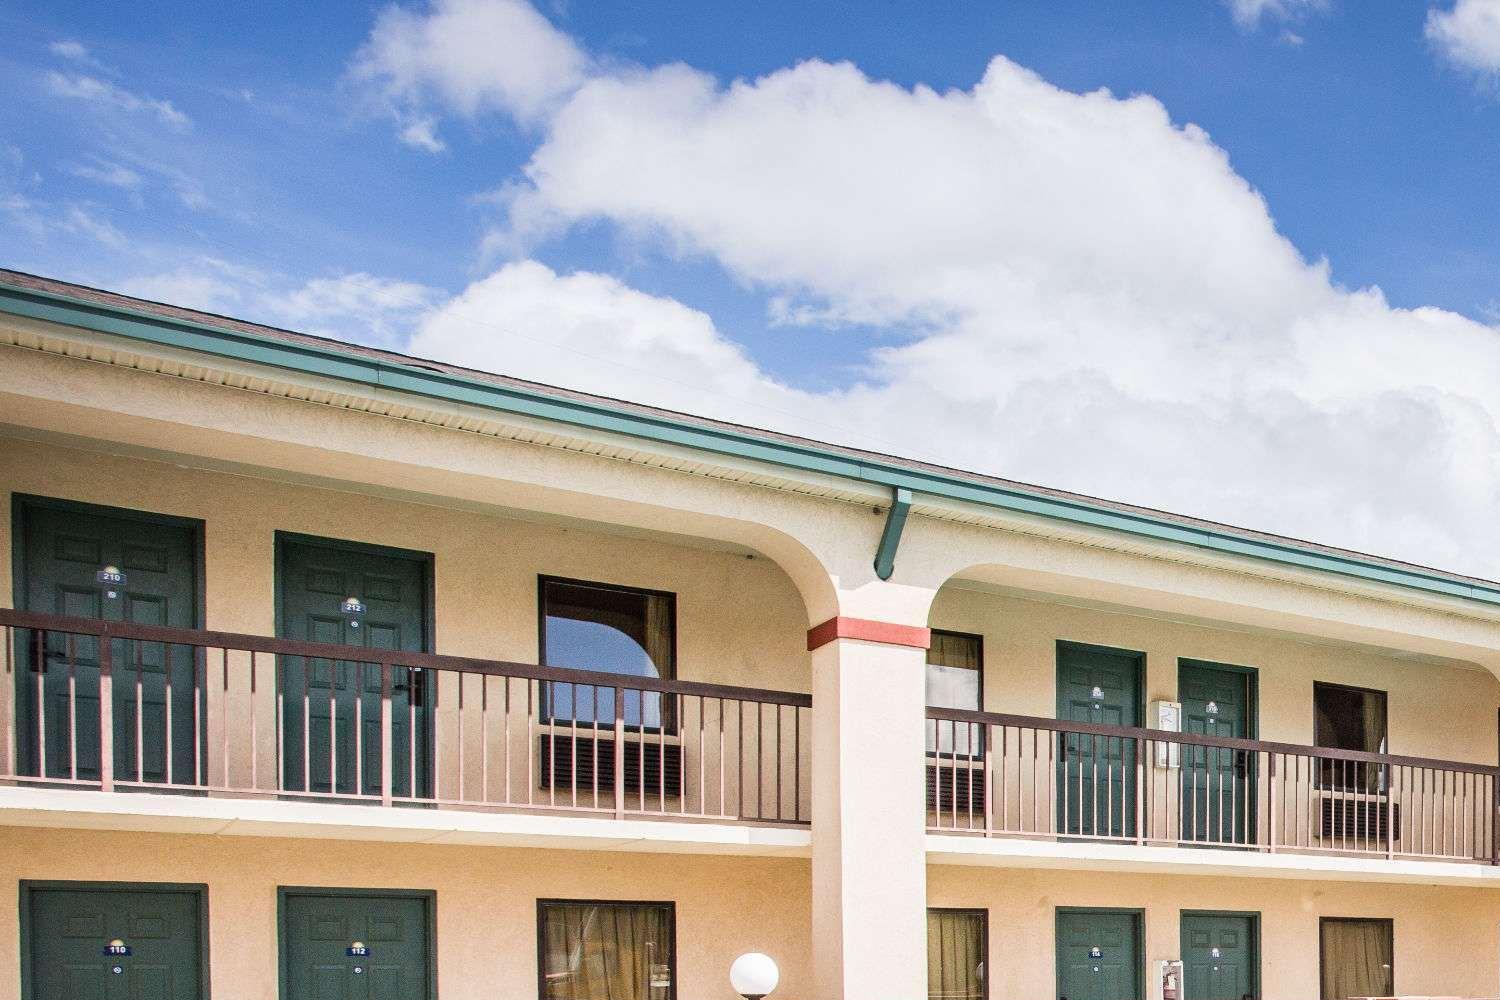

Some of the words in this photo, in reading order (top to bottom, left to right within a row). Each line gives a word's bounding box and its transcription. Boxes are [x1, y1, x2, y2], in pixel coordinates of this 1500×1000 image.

[103, 573, 121, 581] 210
[345, 603, 361, 611] 212
[110, 946, 126, 954] 110
